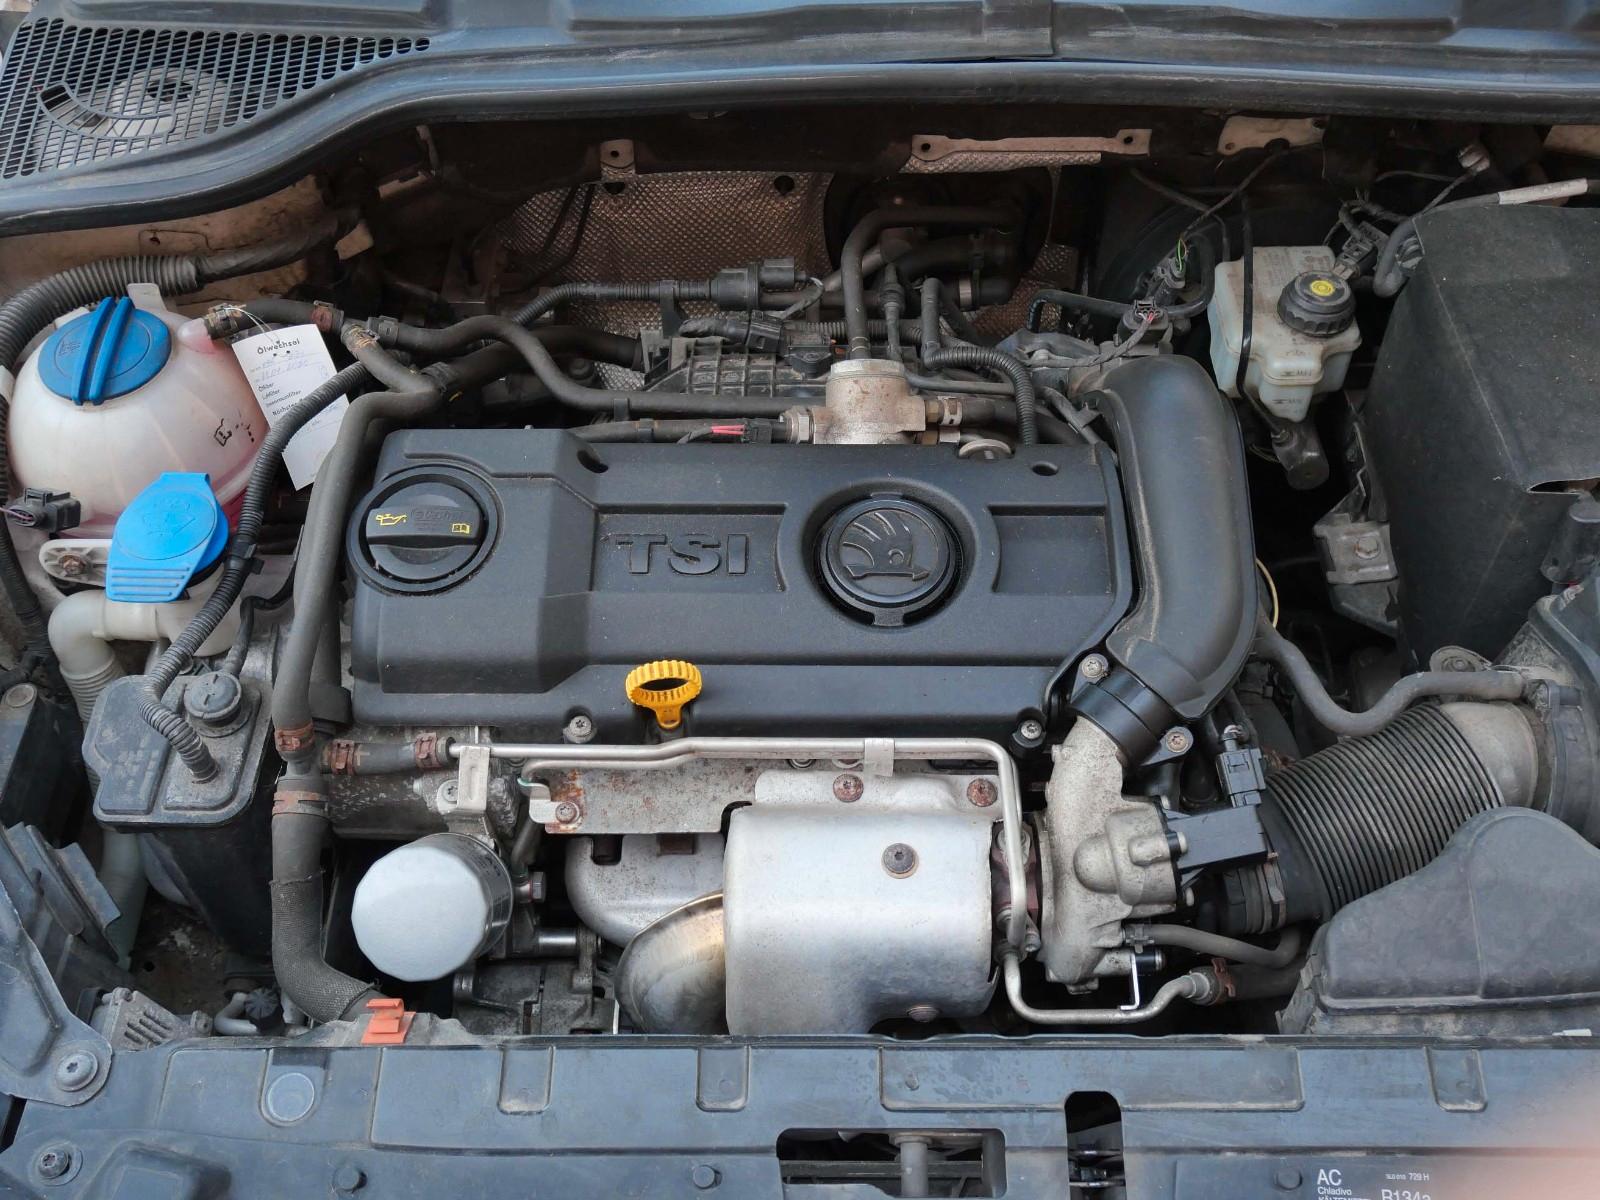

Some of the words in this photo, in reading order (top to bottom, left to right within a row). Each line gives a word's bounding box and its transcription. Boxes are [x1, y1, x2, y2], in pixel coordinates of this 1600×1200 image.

[615, 533, 749, 576] TSI
[1317, 1168, 1342, 1186] AC
[1317, 1186, 1352, 1196] Chladivo
